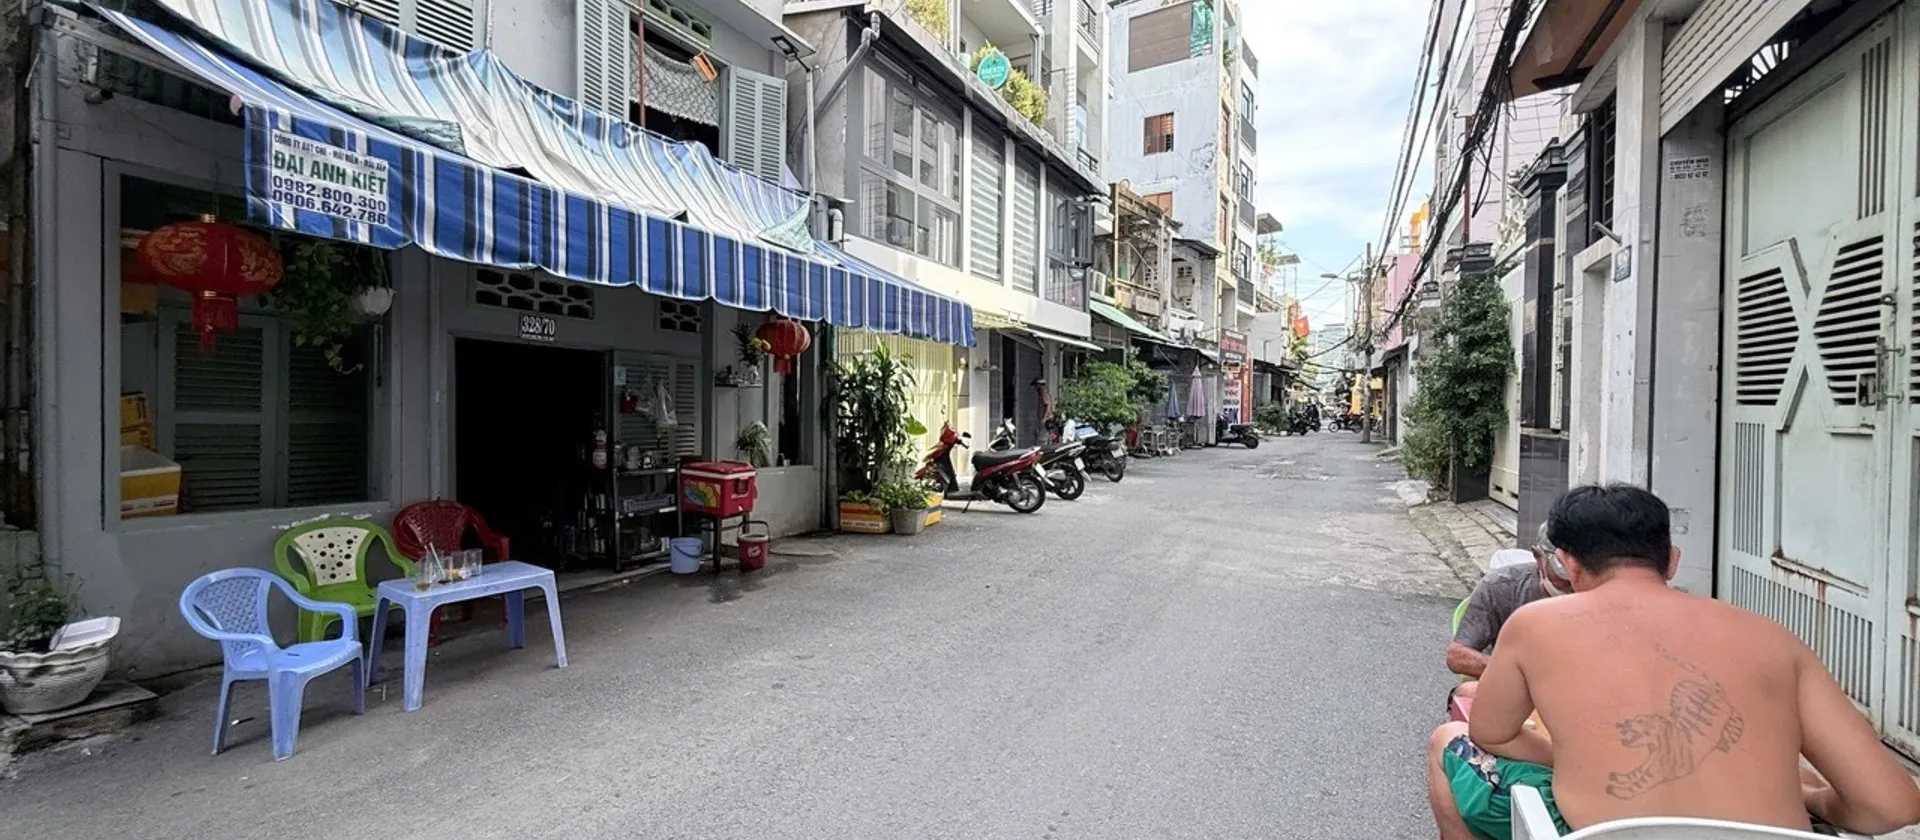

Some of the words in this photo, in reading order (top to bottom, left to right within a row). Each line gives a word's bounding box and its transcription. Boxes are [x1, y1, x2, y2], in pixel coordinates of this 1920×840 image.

[273, 150, 304, 177] ĐẠI
[310, 160, 346, 185] ANH
[352, 170, 387, 196] KIỆT
[273, 175, 386, 212] 0982.800.300
[273, 189, 386, 225] 0906.642.786
